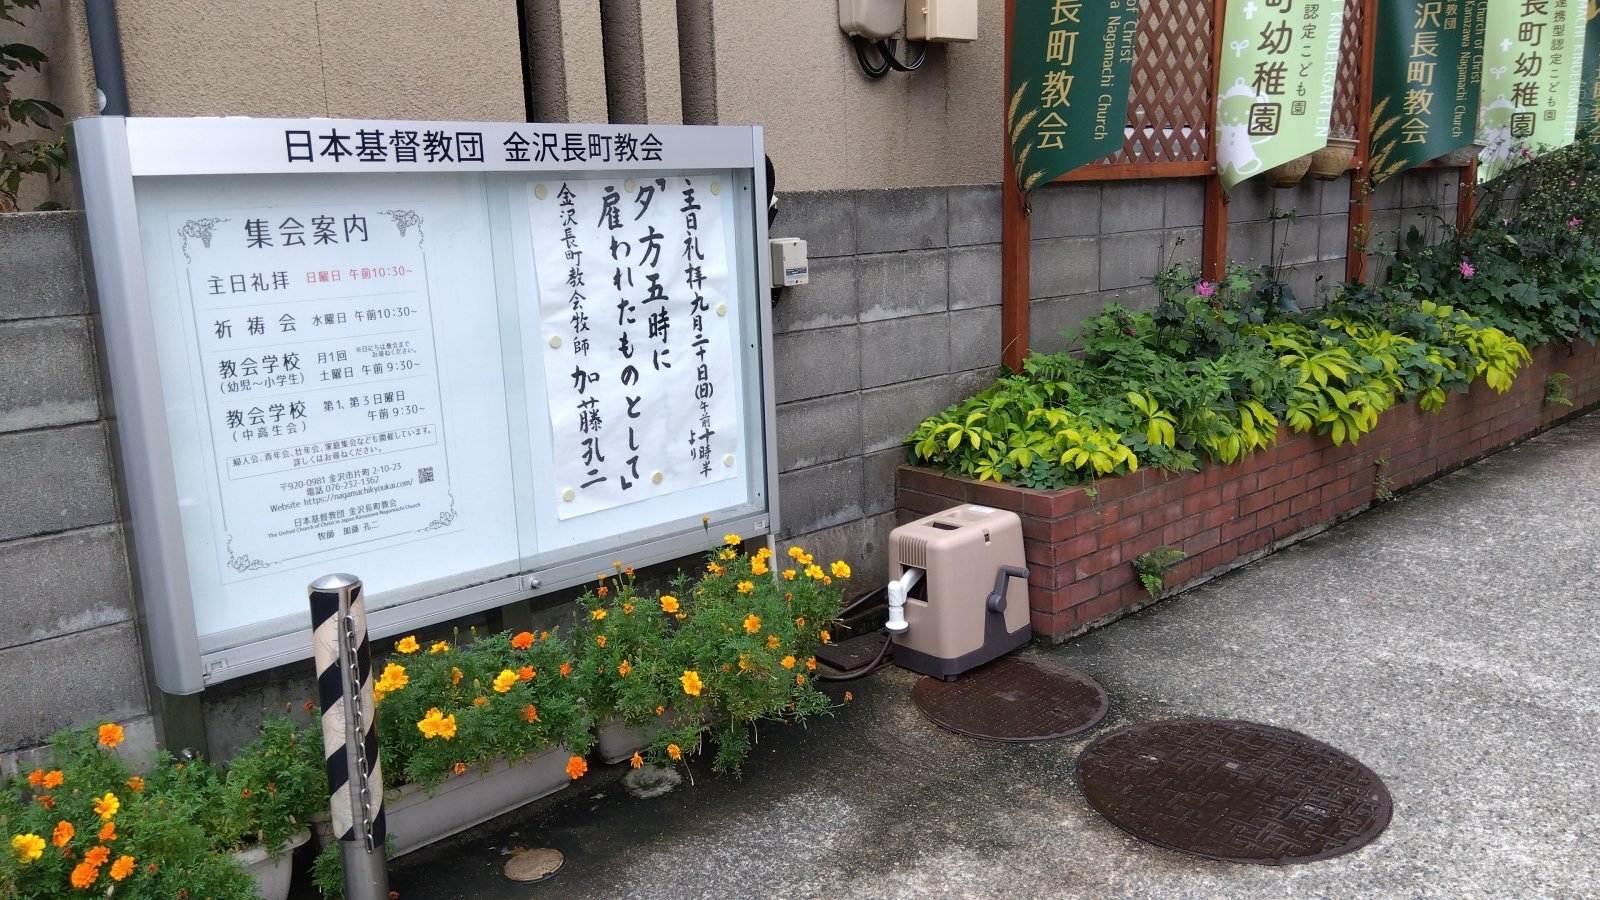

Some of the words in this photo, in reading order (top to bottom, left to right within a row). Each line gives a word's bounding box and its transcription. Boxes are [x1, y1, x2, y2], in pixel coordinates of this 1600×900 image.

[1461, 0, 1475, 48] Kanazawa
[1475, 1, 1488, 35] Church
[1100, 16, 1121, 87] Nagamachi
[1120, 20, 1137, 63] Christ
[1473, 39, 1484, 49] of
[1314, 11, 1344, 137] KINDERGARTEN
[1401, 1, 1442, 144] 沢長町教会
[1456, 51, 1471, 101] Nagamachi
[1470, 55, 1484, 84] Christ
[1564, 44, 1584, 137] KINDERGARTEN
[1094, 94, 1113, 140] Church
[1451, 105, 1466, 138] Church
[285, 128, 485, 163] 日本基督教団
[503, 131, 663, 163] 金沢長町教会
[244, 213, 369, 249] 集会案内
[207, 271, 290, 295] 主日礼拝
[306, 270, 341, 284] 日曜日
[311, 312, 347, 327] 水曜日
[218, 352, 301, 380] 教会学校
[317, 350, 347, 364] 月1回
[319, 366, 354, 382] 土曜日
[225, 400, 308, 429] 教会学校
[232, 421, 306, 443] (中高生会)
[306, 486, 324, 497] 電話
[325, 476, 380, 493] 076-232-1362
[328, 468, 370, 483] 金沢市片町
[372, 462, 402, 475] 2-10-23
[269, 501, 301, 513] Website
[303, 478, 413, 506] https://nagamachikyoukai.com/
[278, 528, 296, 537] United
[296, 524, 314, 533] Church
[404, 502, 421, 510] Church
[294, 509, 345, 528] 日本基督教団
[348, 498, 397, 516] 金沢長町教会
